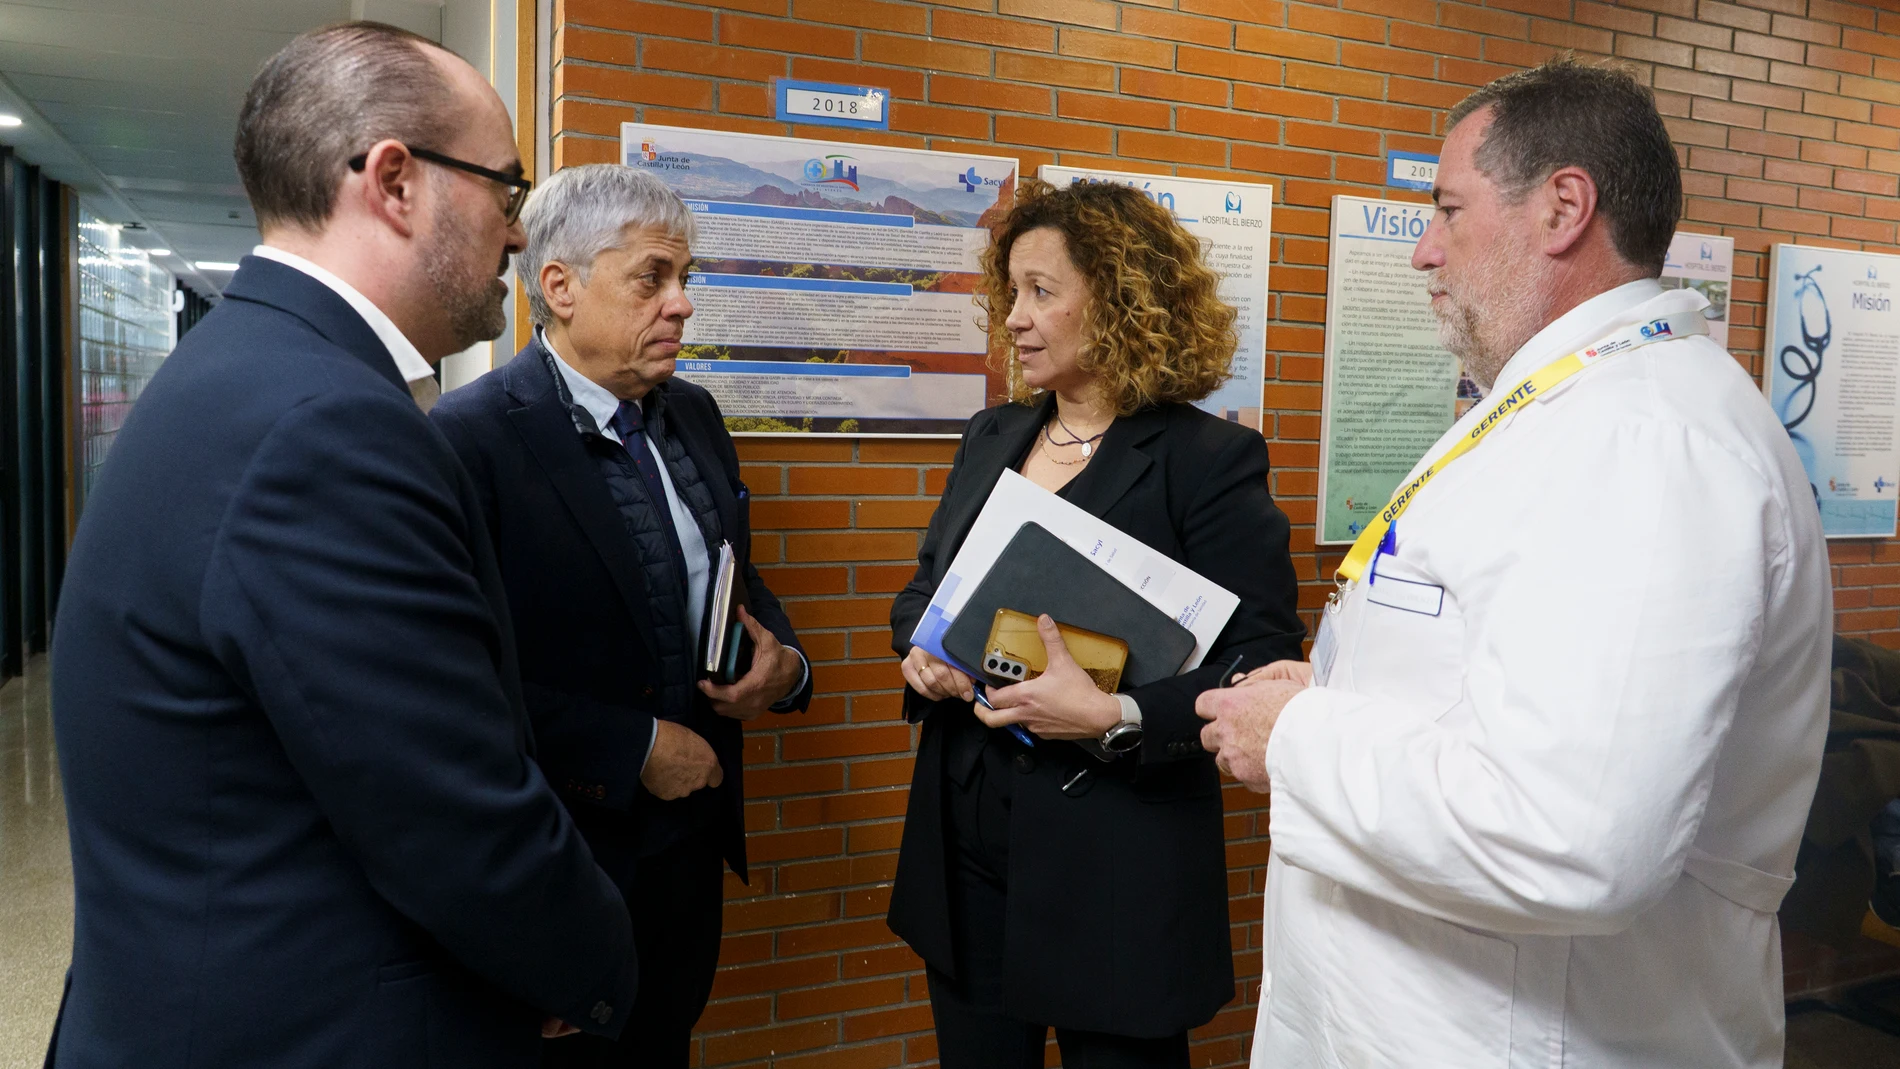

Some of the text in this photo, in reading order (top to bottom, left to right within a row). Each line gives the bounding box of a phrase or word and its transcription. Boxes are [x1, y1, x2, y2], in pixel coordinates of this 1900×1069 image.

[813, 98, 858, 114] 2018
[637, 160, 664, 169] Castilla
[658, 155, 679, 164] Junta
[1411, 166, 1433, 178] 201
[984, 178, 1006, 187] Sacyl
[688, 203, 708, 211] MISIÓN
[1203, 216, 1262, 228] HOSPITAL EL BIERZO
[1363, 205, 1430, 238] Visió
[1852, 293, 1890, 312] Misión
[1471, 380, 1537, 439] GERENTE
[1383, 465, 1434, 522] GERENTE
[1090, 539, 1103, 556] Sacyl
[1193, 596, 1202, 608] León
